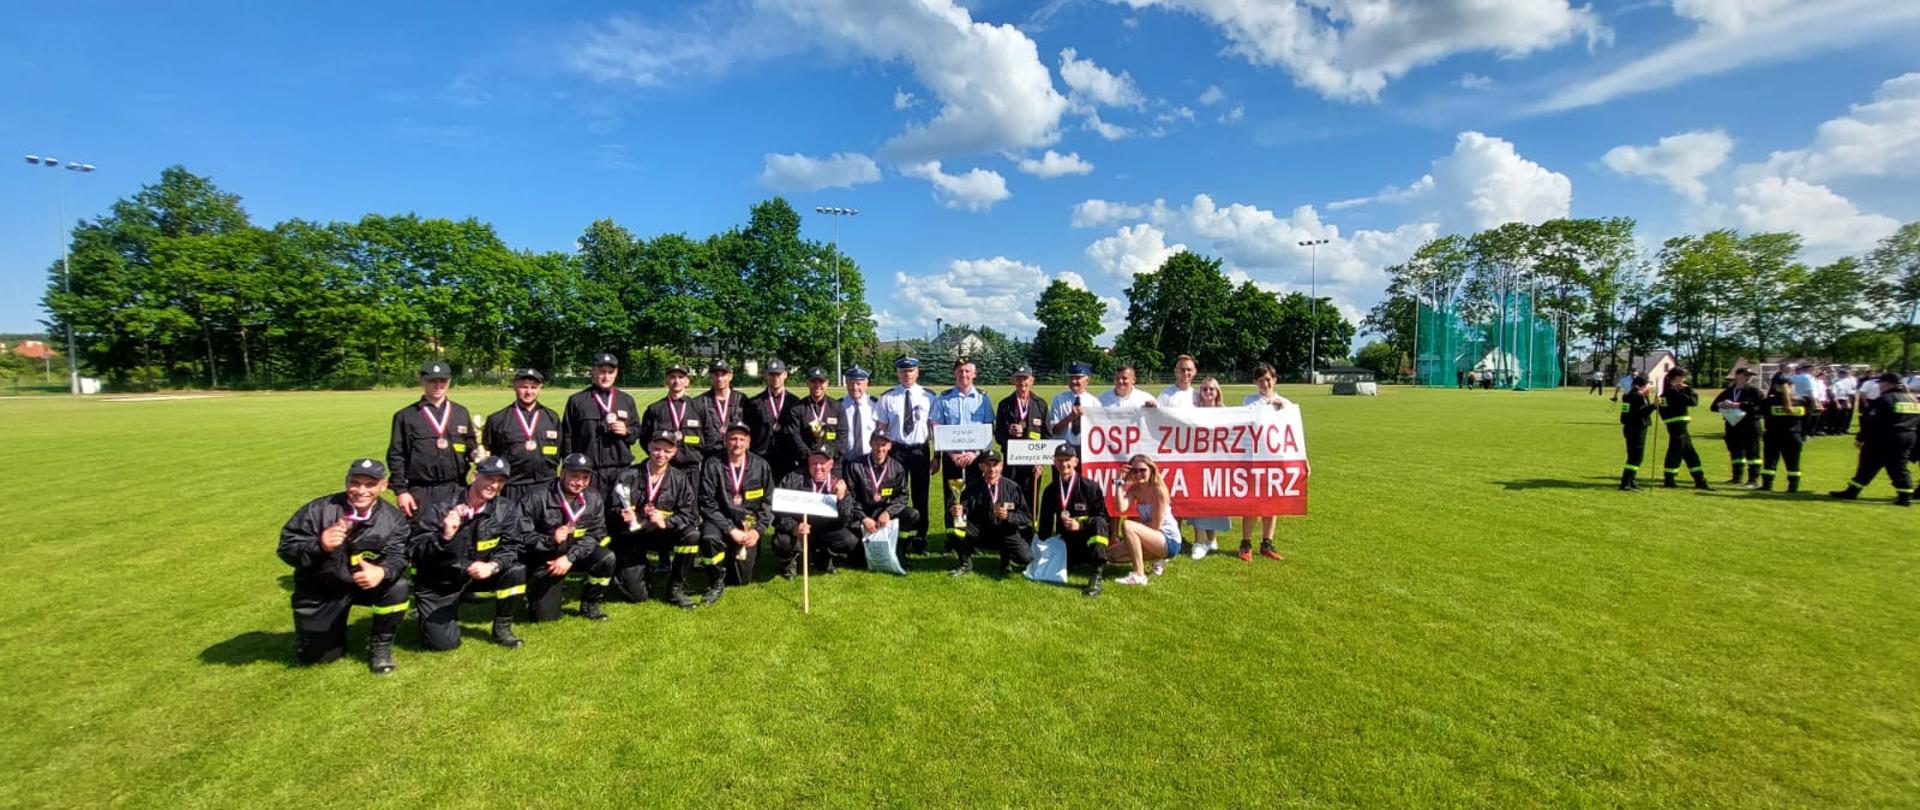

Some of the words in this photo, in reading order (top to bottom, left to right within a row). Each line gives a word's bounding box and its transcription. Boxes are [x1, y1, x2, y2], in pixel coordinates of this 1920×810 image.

[1027, 443, 1047, 451] OSP
[1088, 425, 1141, 455] OSP
[1157, 424, 1299, 455] ZUBRZYCA
[1087, 467, 1189, 498] WIA
[1203, 467, 1301, 498] MISTRZ
